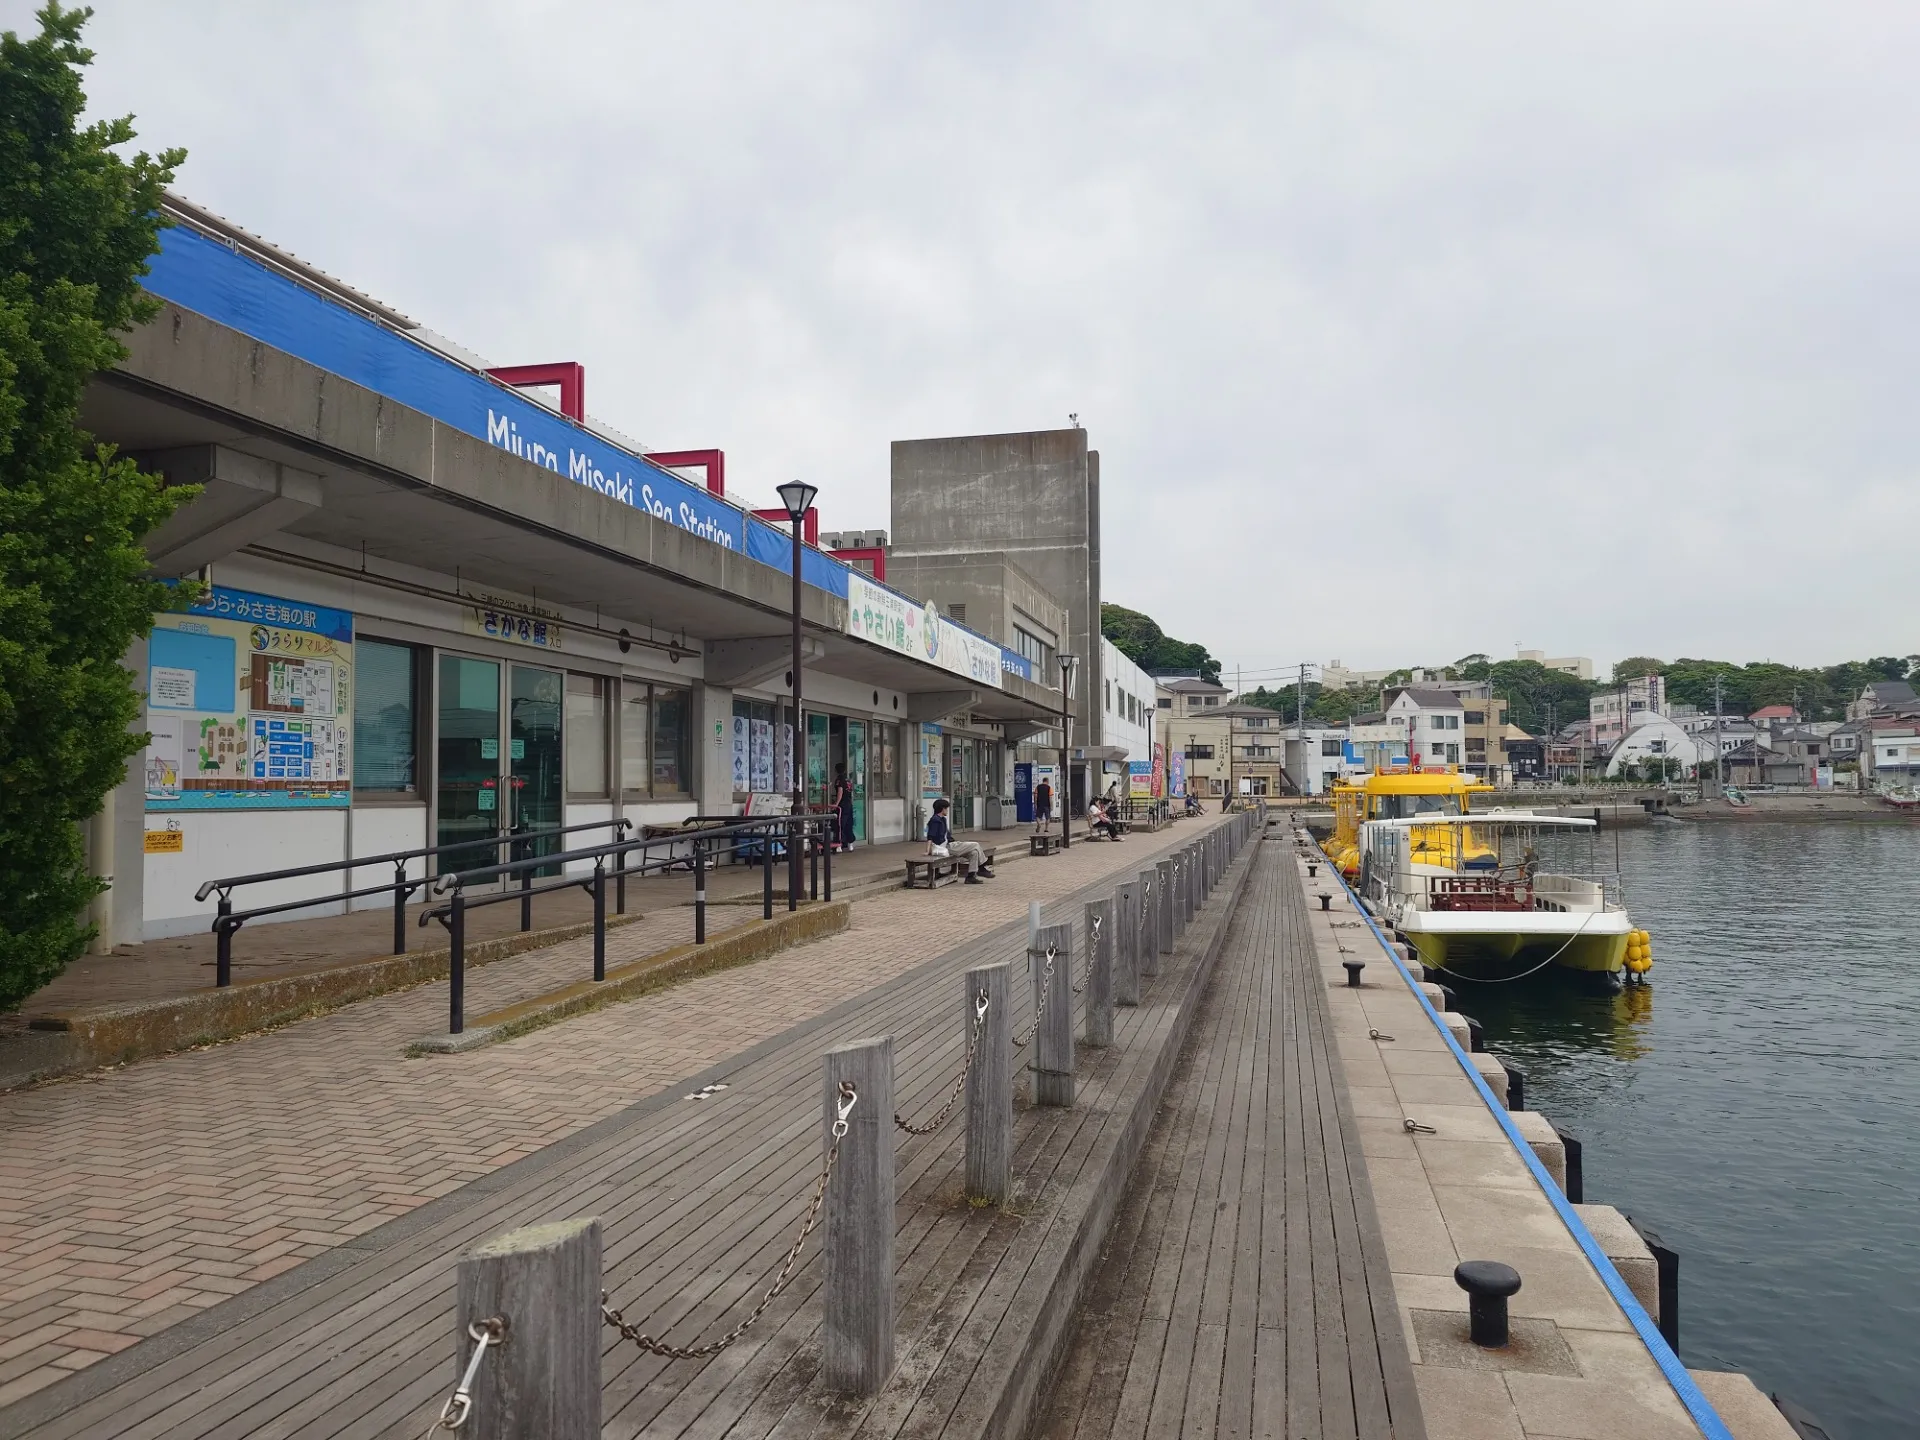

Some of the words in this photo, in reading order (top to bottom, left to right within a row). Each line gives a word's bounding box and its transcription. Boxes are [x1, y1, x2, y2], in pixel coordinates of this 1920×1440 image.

[487, 408, 557, 472] Miura
[569, 448, 633, 506] Misaki
[641, 484, 673, 524] Sea
[679, 502, 732, 550] Station
[484, 611, 547, 645] さかな館
[863, 604, 905, 649] やさい館
